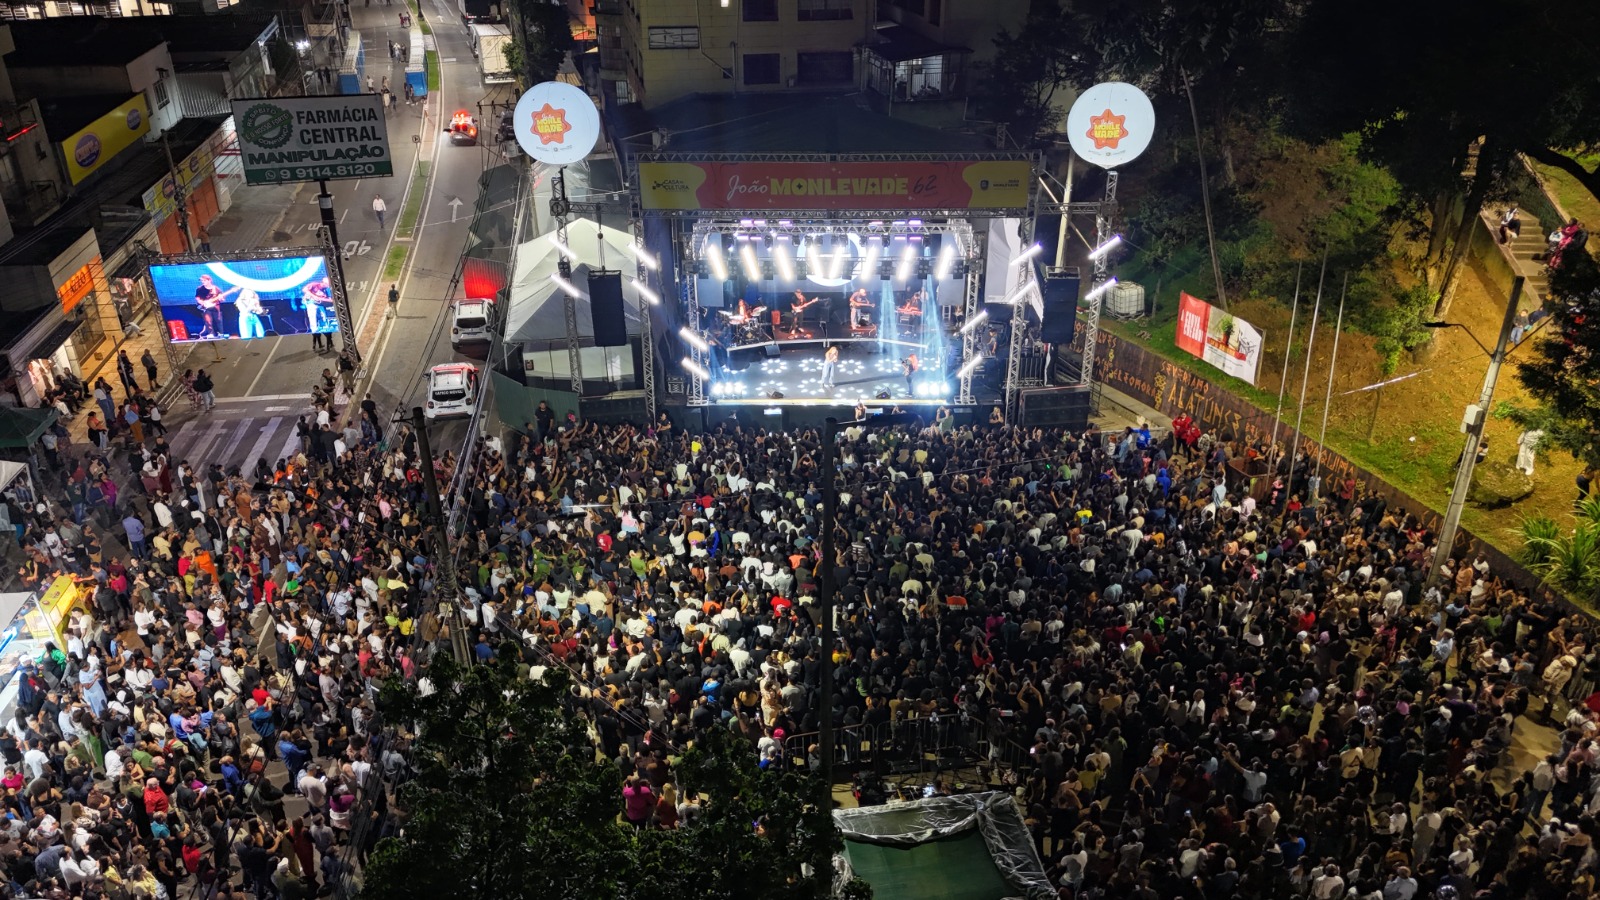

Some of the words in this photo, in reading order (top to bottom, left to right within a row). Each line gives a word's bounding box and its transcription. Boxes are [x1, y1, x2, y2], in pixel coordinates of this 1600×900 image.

[247, 107, 277, 127] RESPEITO
[296, 106, 378, 125] FARMÁCIA
[300, 126, 382, 145] CENTRAL
[247, 144, 385, 165] MANIPULAÇÃO
[279, 169, 291, 179] 9
[295, 163, 375, 178] 9114.8120
[726, 174, 768, 201] João
[770, 177, 908, 196] MONLEVADE
[913, 175, 937, 194] 62
